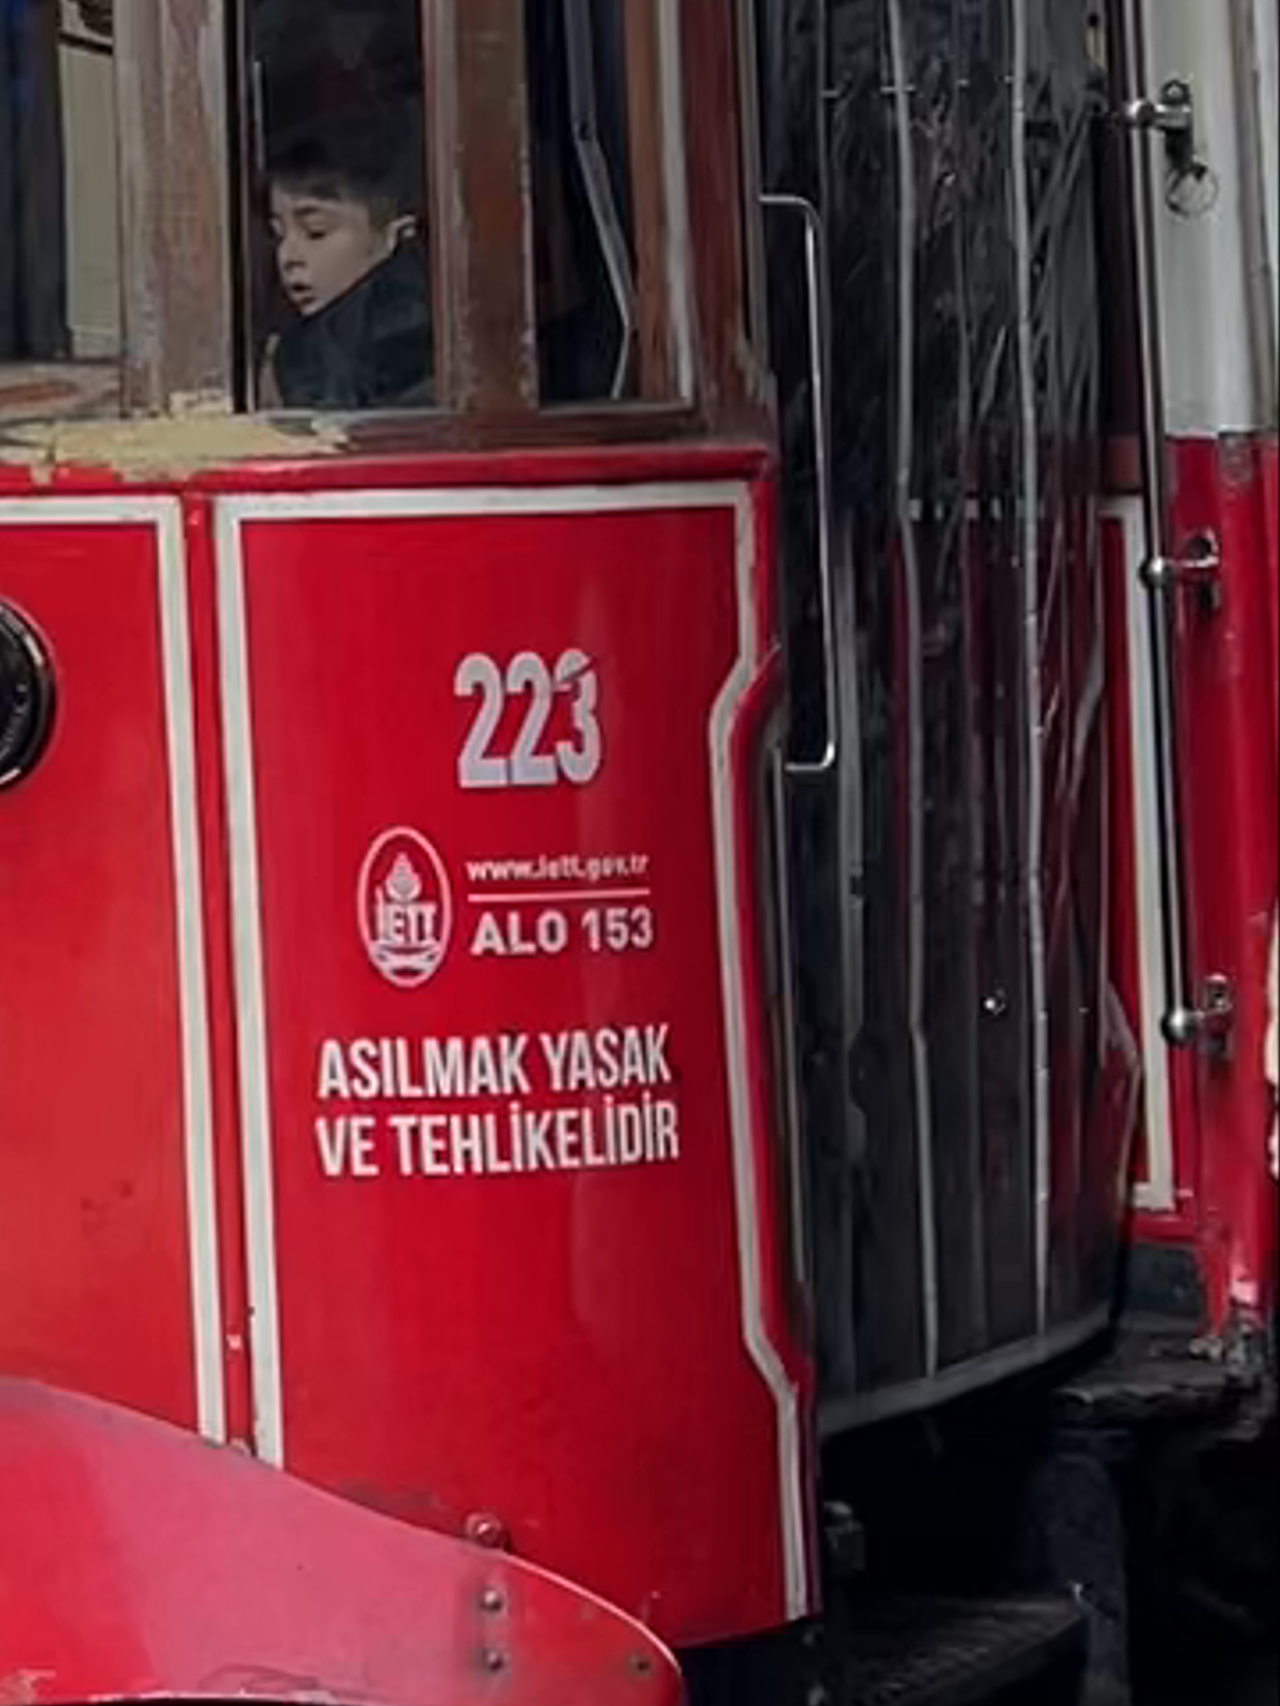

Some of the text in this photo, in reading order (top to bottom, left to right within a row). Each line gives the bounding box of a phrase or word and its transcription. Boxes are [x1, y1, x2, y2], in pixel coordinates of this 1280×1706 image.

[453, 647, 602, 789] 223
[469, 903, 654, 957] ALO 153
[316, 1022, 672, 1100] ASILMAK YASAK
[314, 1089, 681, 1178] VE TEHLİKELİDİR
